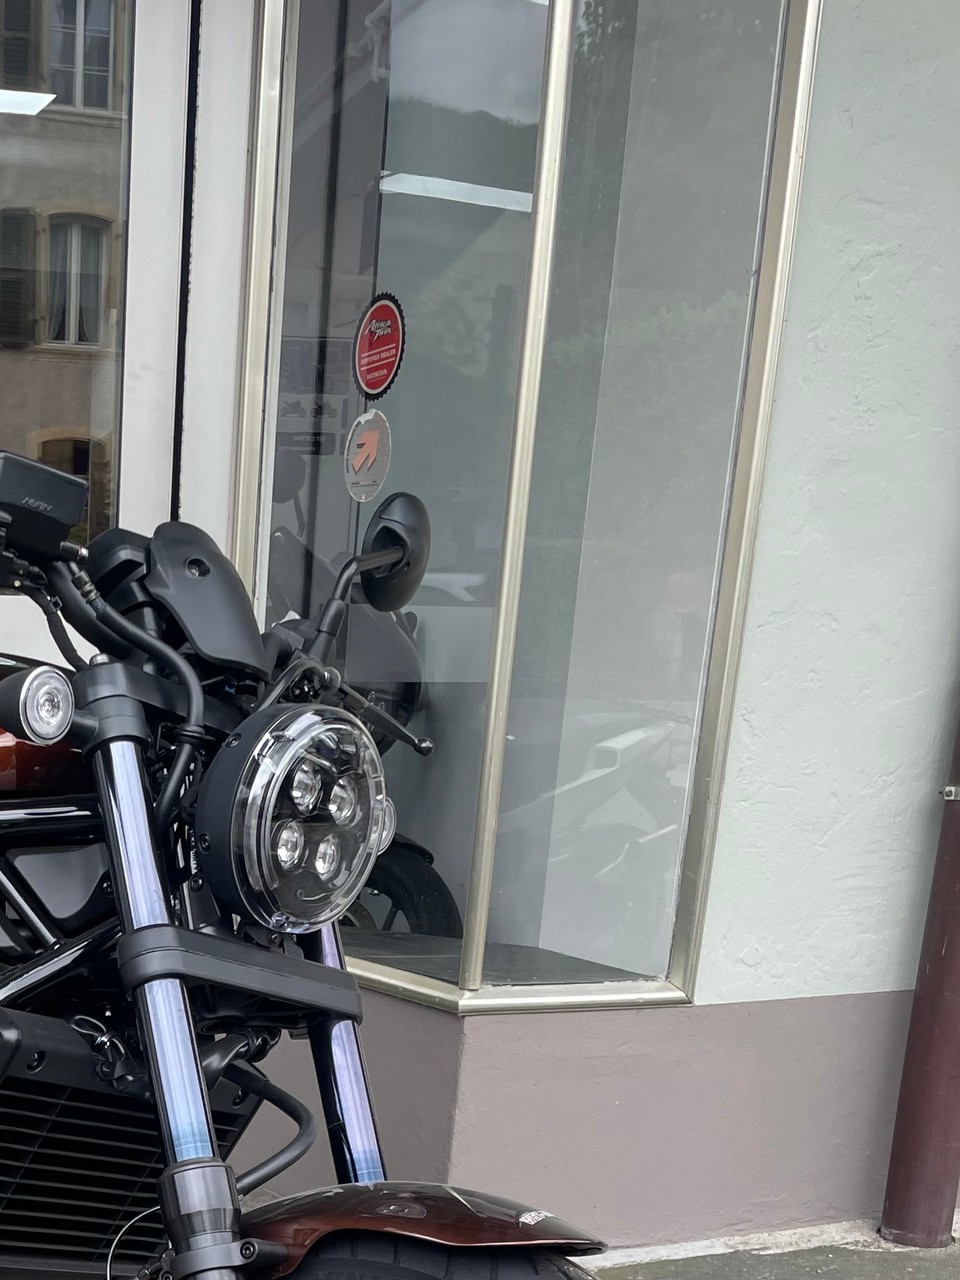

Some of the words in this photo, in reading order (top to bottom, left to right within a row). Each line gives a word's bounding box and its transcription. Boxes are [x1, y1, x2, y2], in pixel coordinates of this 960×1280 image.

[363, 319, 392, 335] Africa
[372, 328, 393, 342] Twin
[380, 348, 396, 359] DEALER
